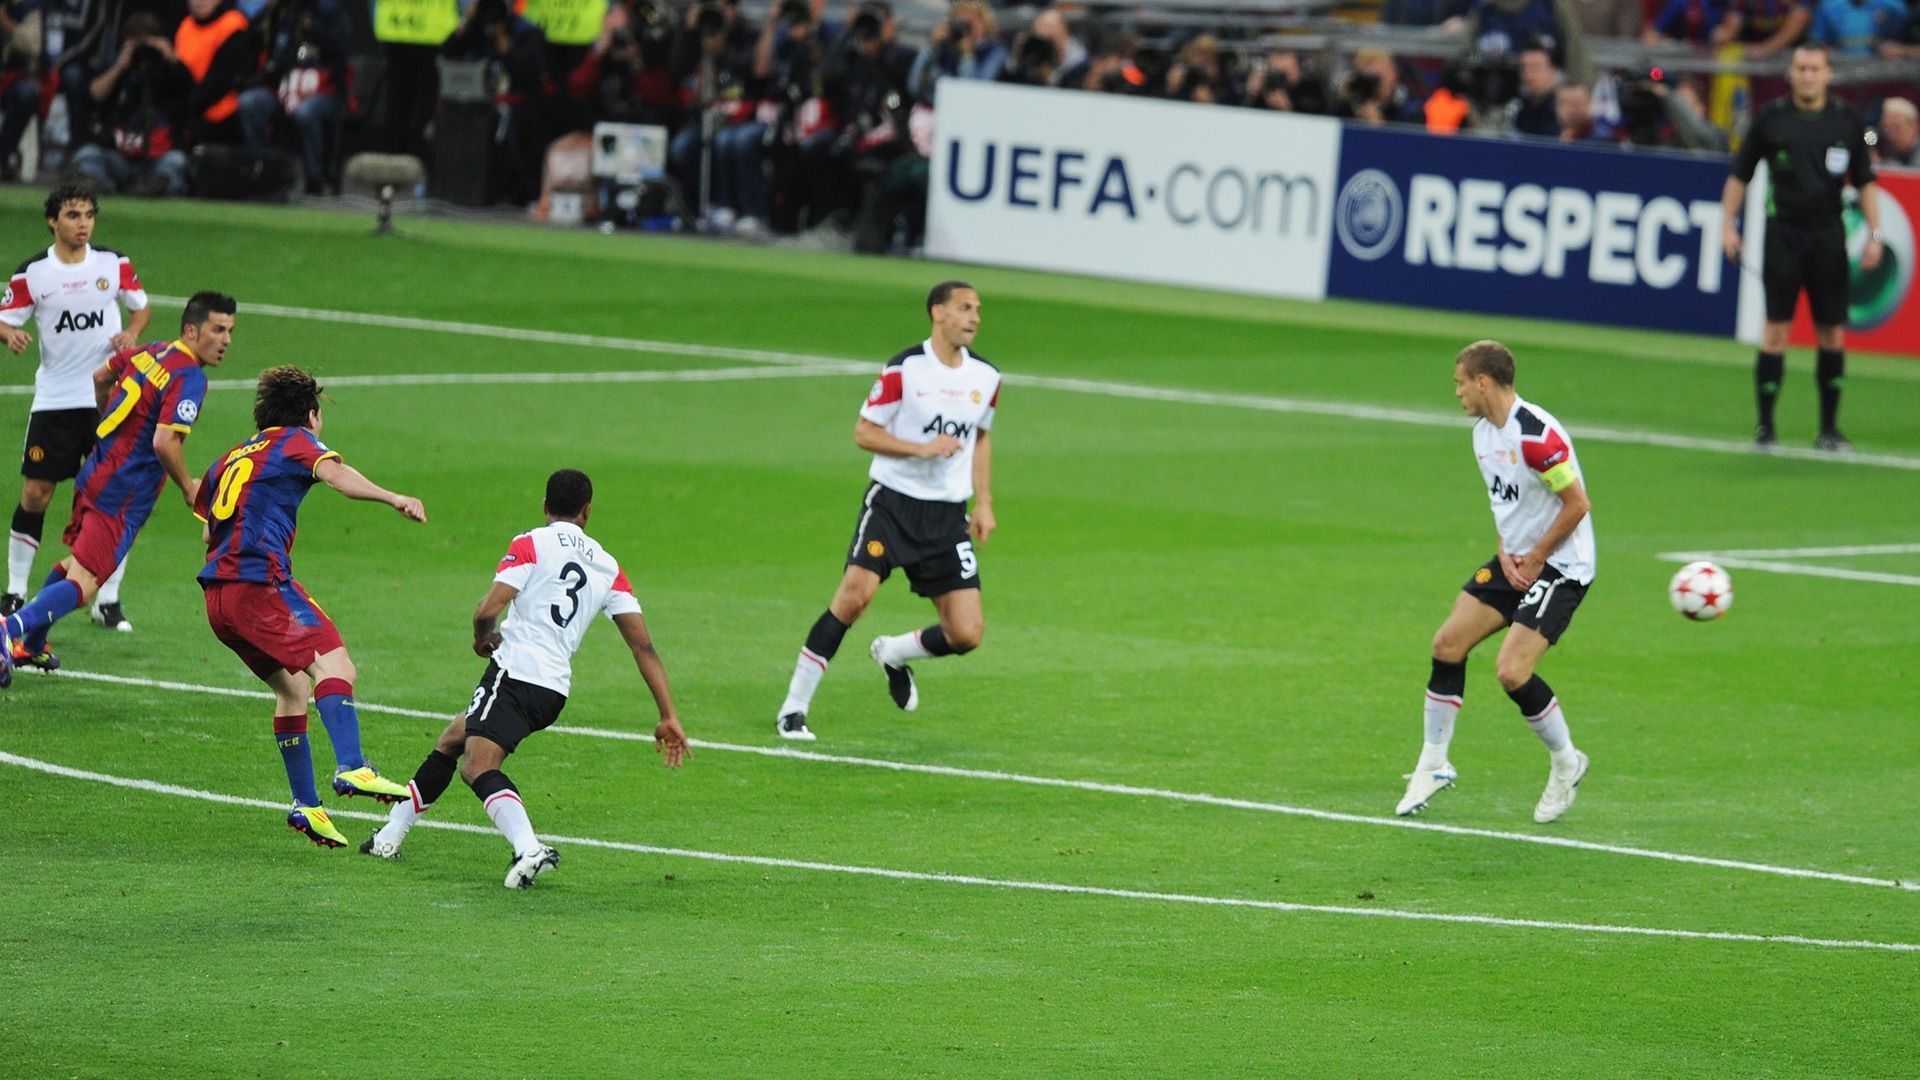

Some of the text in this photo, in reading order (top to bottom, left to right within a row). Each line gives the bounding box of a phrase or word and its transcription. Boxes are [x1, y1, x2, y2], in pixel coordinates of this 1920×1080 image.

[1403, 173, 1724, 294] RESPECT
[55, 309, 104, 333] AON
[96, 375, 141, 439] 7
[923, 413, 973, 439] AON
[557, 533, 594, 562] EVRA
[955, 540, 978, 580] 5
[550, 561, 588, 629] 3
[1518, 579, 1551, 610] 5
[465, 686, 486, 719] 3
[279, 736, 300, 748] FCB
